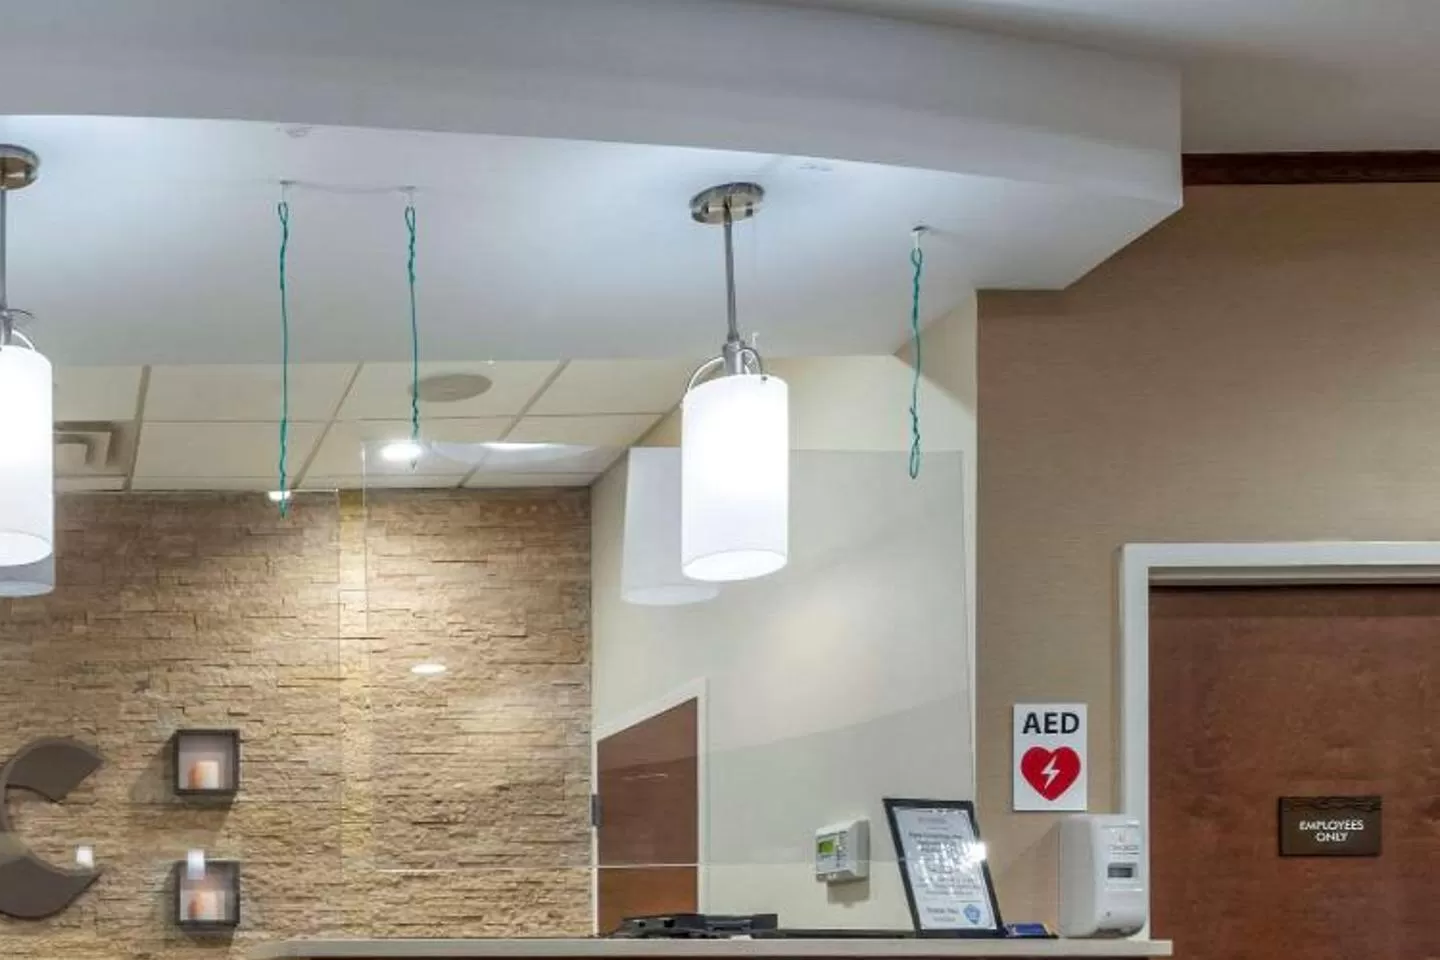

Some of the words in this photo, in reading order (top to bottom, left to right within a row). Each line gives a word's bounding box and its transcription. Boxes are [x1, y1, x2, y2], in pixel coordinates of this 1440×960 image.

[1022, 711, 1080, 734] AED
[1299, 820, 1364, 830] EMPLOYEES
[1316, 832, 1348, 842] ONLY
